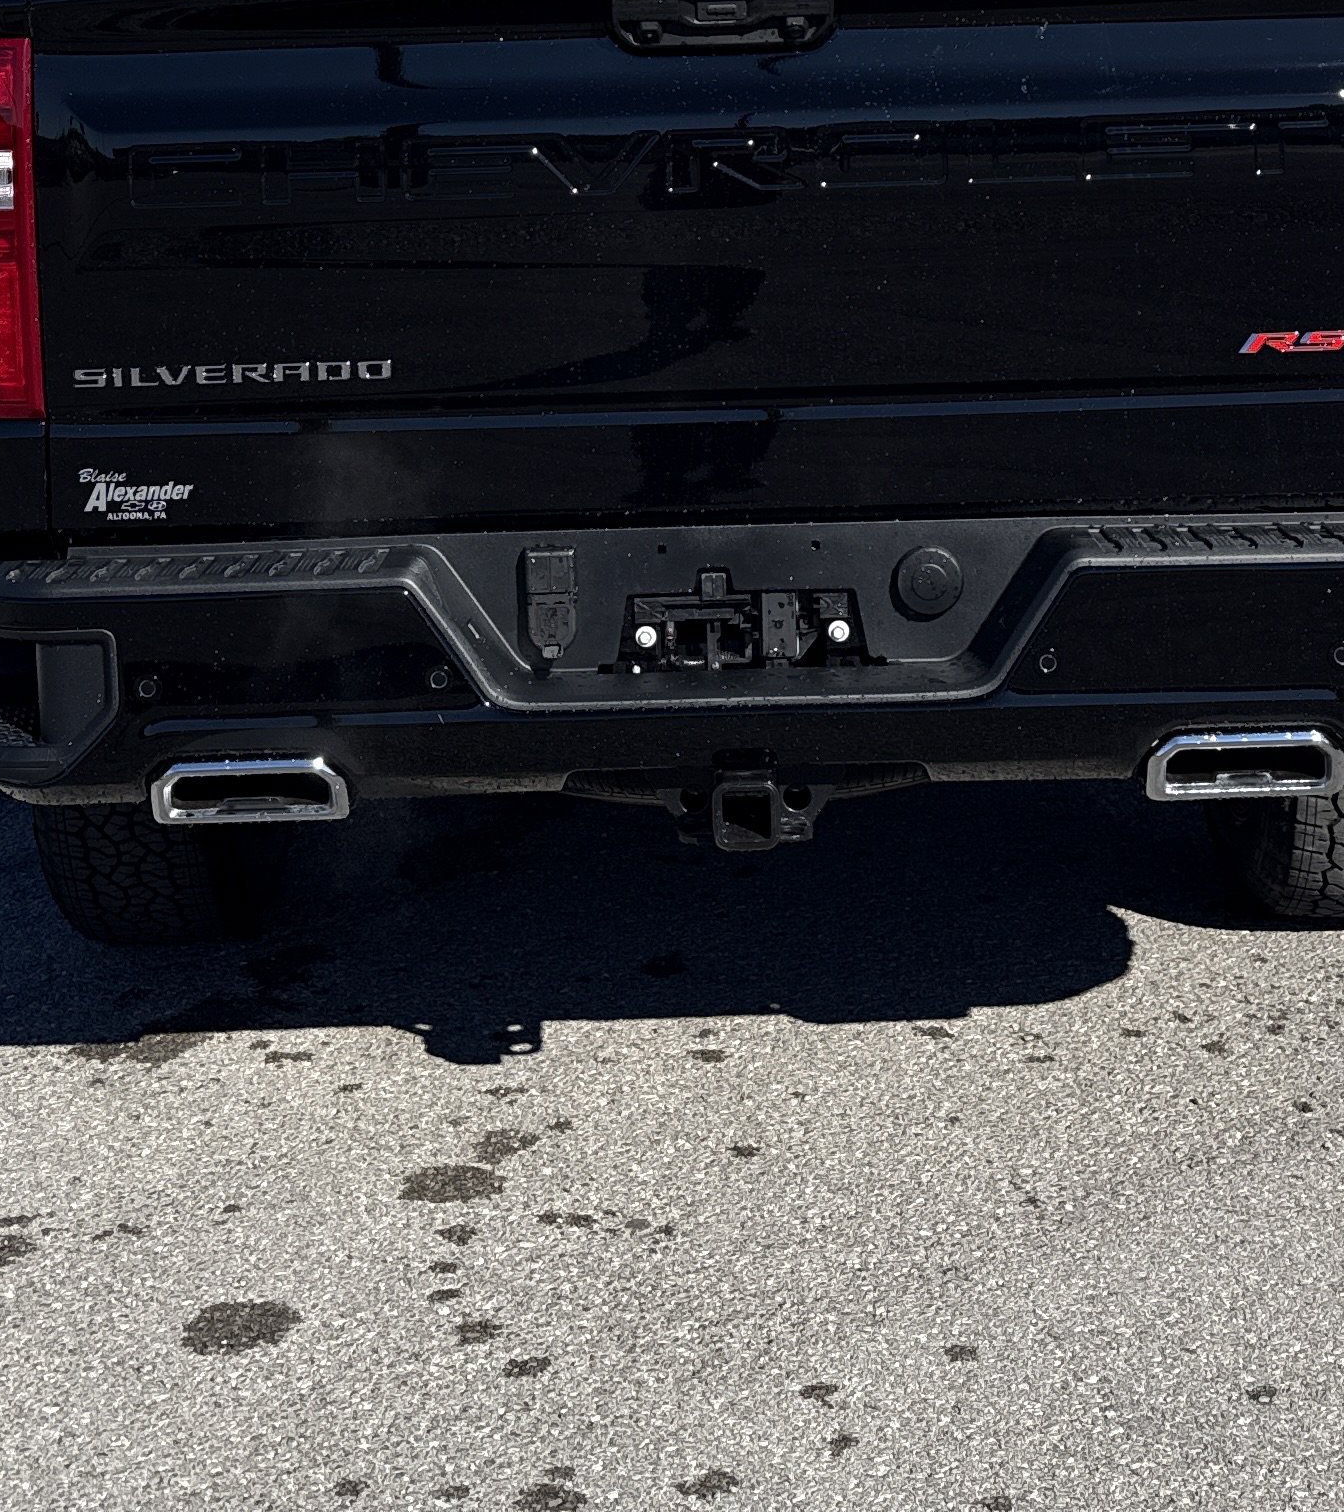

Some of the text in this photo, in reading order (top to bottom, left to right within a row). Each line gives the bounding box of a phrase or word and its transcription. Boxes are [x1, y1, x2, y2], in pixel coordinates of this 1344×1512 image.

[73, 359, 392, 388] SILVERADO
[78, 468, 127, 483] Blaise
[83, 481, 194, 512] Alexander
[106, 511, 167, 521] ALTOONA, PA
